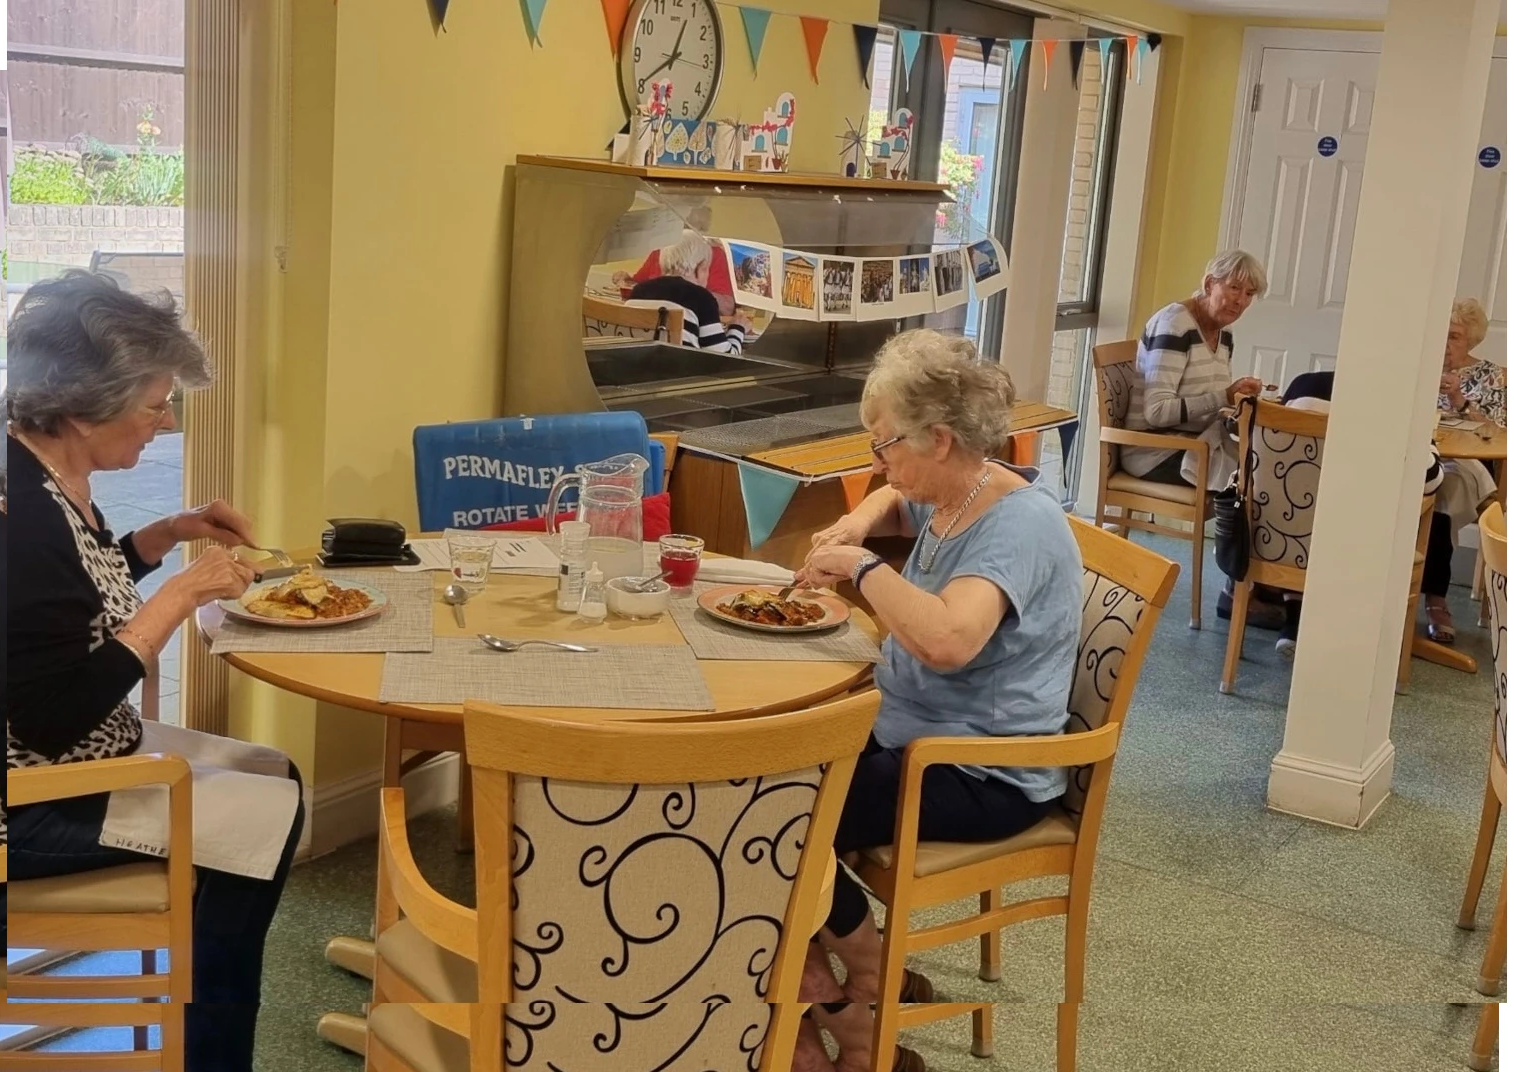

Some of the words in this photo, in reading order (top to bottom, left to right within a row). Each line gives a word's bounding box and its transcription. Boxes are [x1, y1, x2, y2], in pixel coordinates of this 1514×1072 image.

[654, 0, 666, 15] 11
[691, 3, 697, 18] 1
[641, 19, 654, 35] 10
[700, 25, 707, 41] 2
[634, 47, 642, 63] 9
[702, 54, 710, 70] 3
[638, 78, 645, 95] 8
[694, 81, 702, 97] 4
[681, 101, 689, 117] 5
[453, 504, 529, 527] ROTATE
[115, 838, 167, 856] HEATHE
